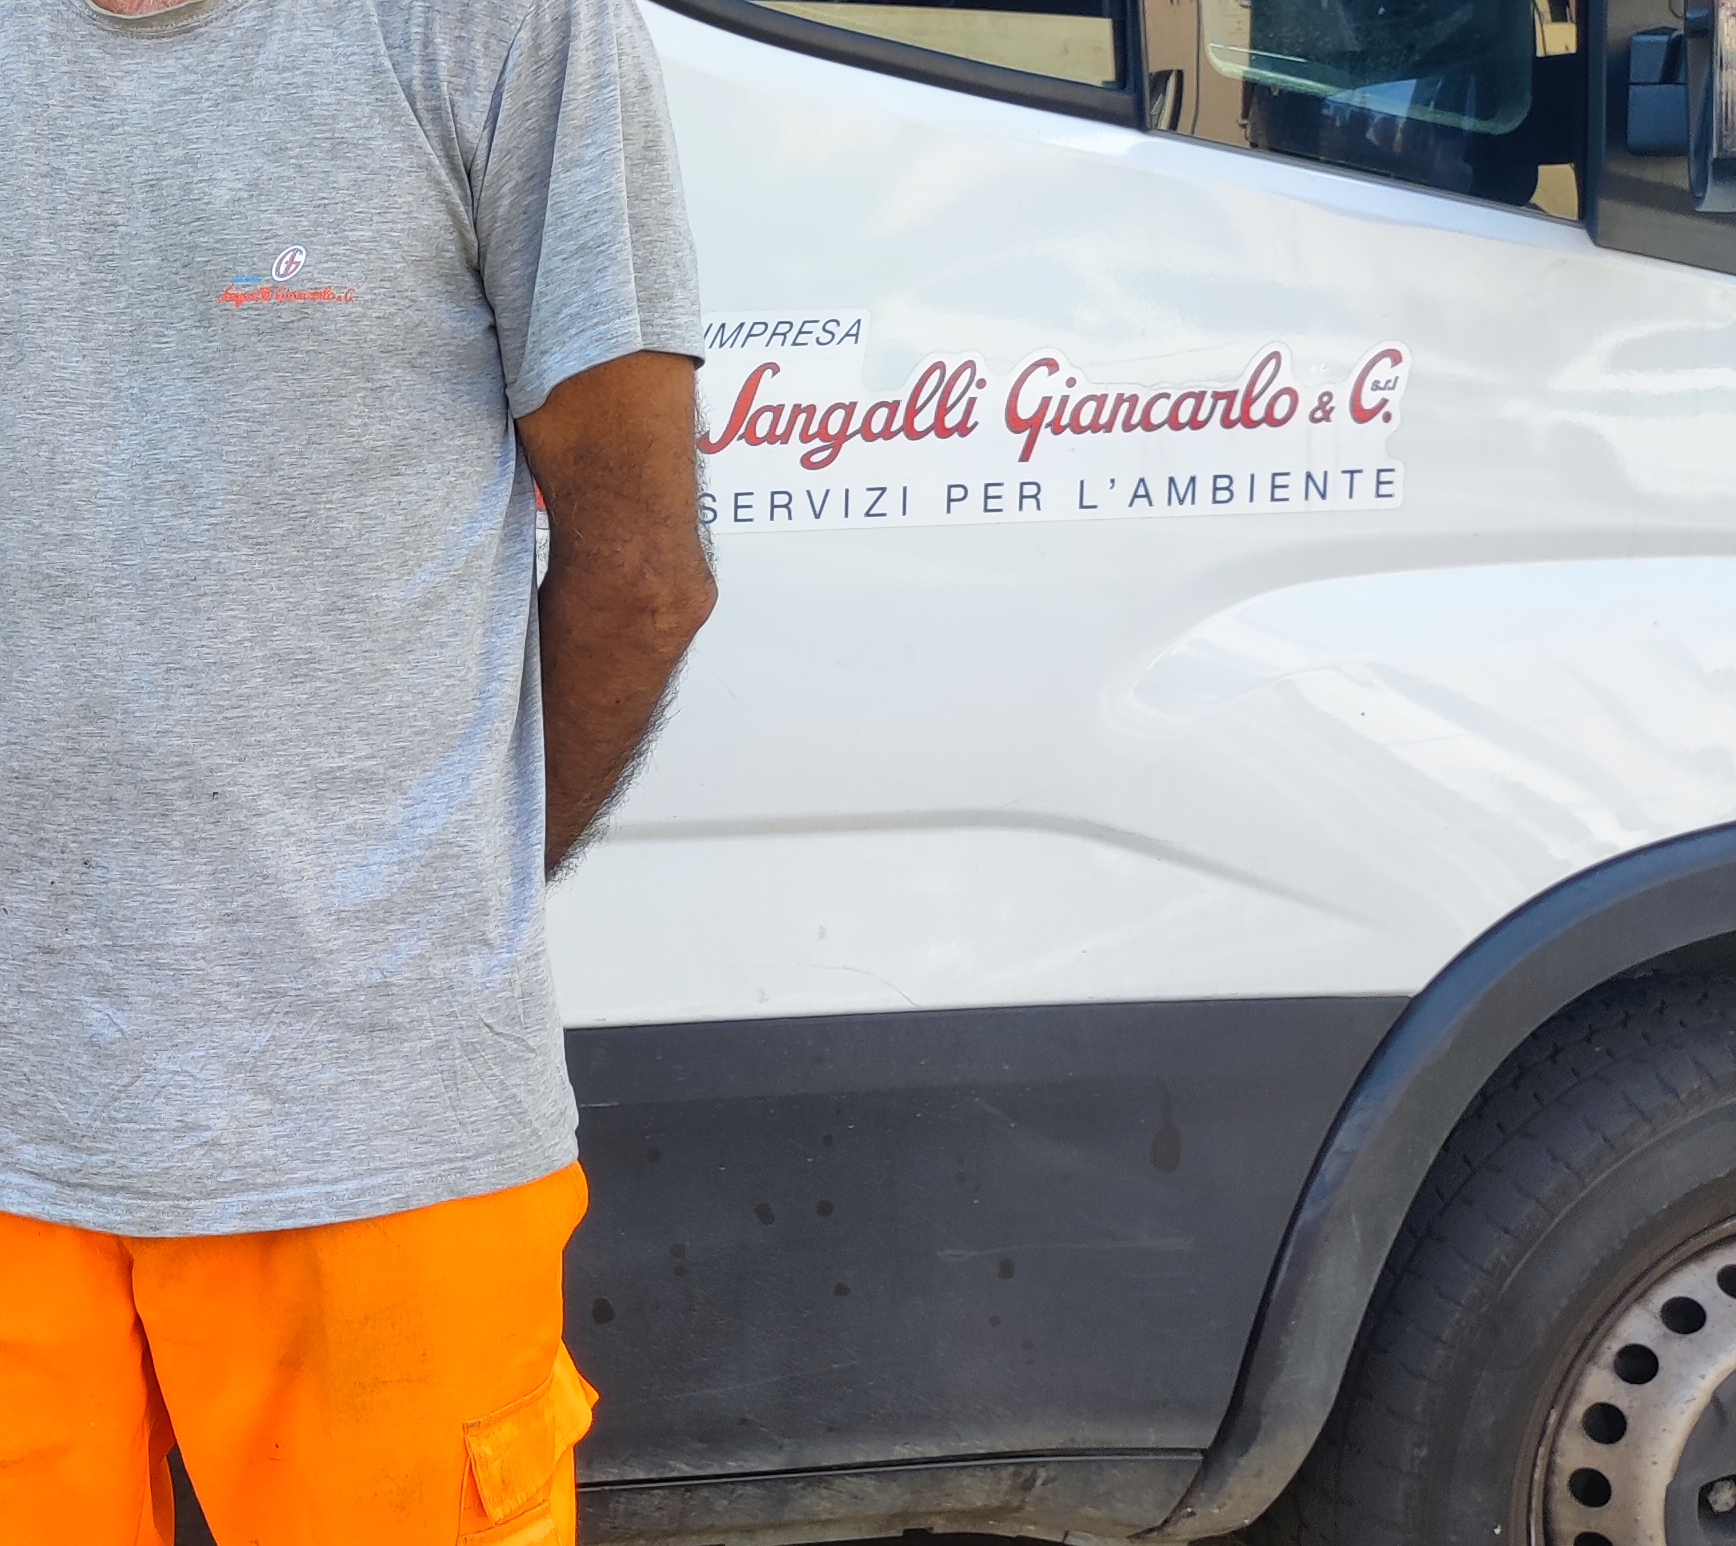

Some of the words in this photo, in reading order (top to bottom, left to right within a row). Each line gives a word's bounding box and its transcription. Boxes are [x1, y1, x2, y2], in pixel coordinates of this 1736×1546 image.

[704, 318, 861, 349] IMPRESA
[696, 359, 988, 471] Sangalli
[1005, 350, 1300, 463] Giancarlo
[1308, 390, 1335, 424] &
[1349, 348, 1403, 425] C.
[700, 486, 907, 525] SERVIZI
[946, 481, 1042, 515] PER
[1078, 467, 1396, 510] L'AMBIENTE
